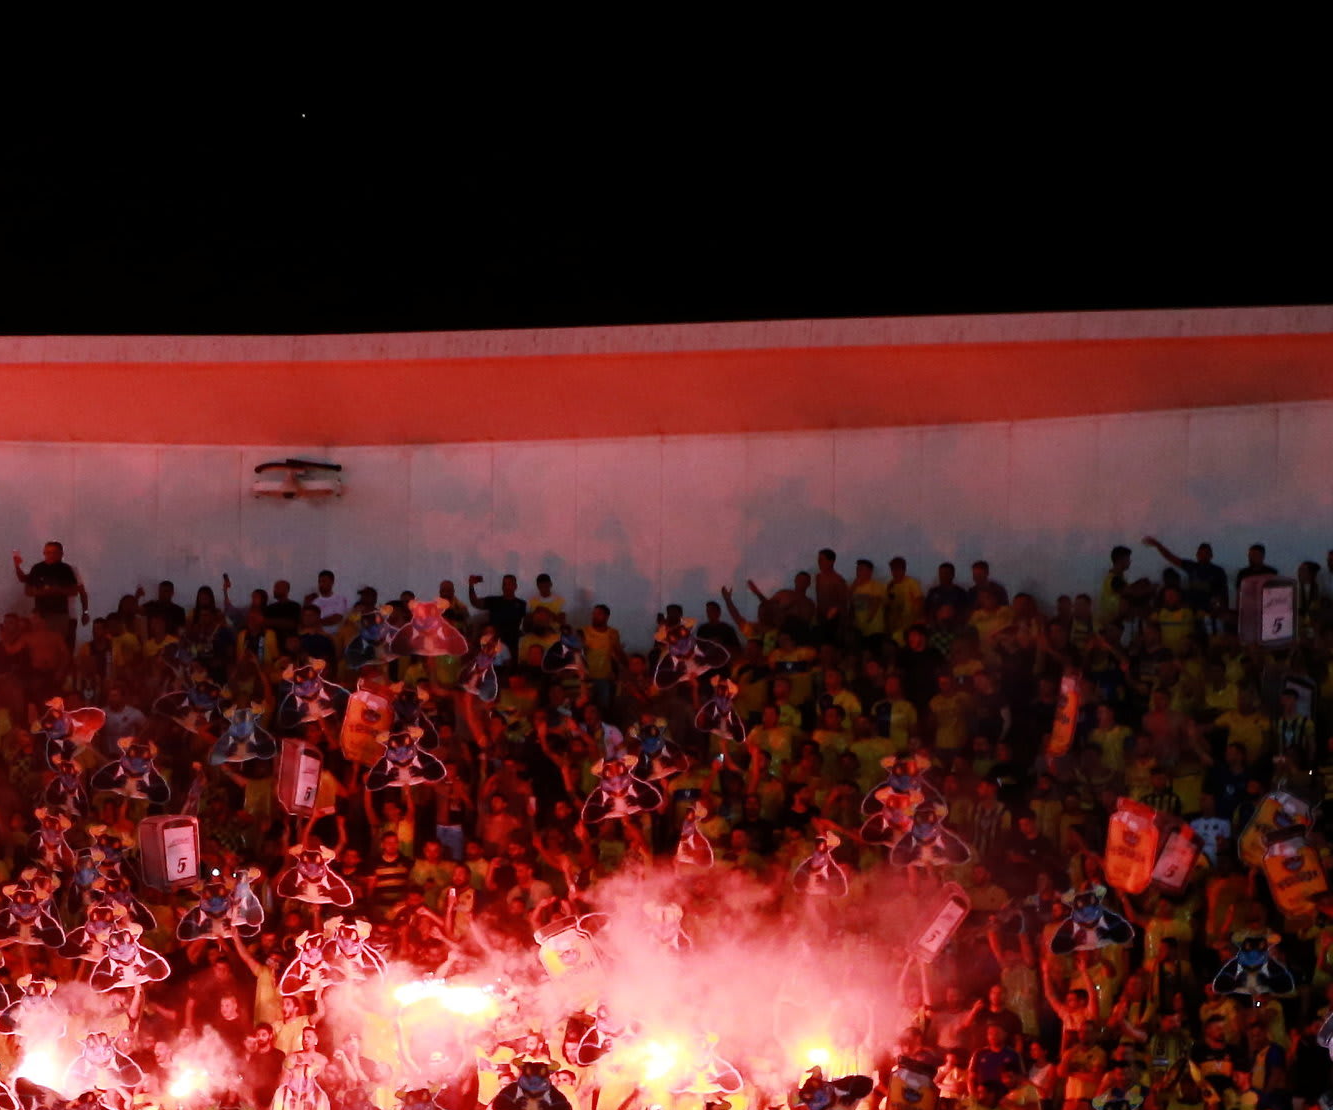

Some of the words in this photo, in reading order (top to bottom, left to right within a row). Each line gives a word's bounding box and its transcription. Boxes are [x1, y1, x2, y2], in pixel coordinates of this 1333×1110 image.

[1273, 618, 1284, 633] 5
[304, 787, 312, 800] 5
[177, 858, 187, 872] 5
